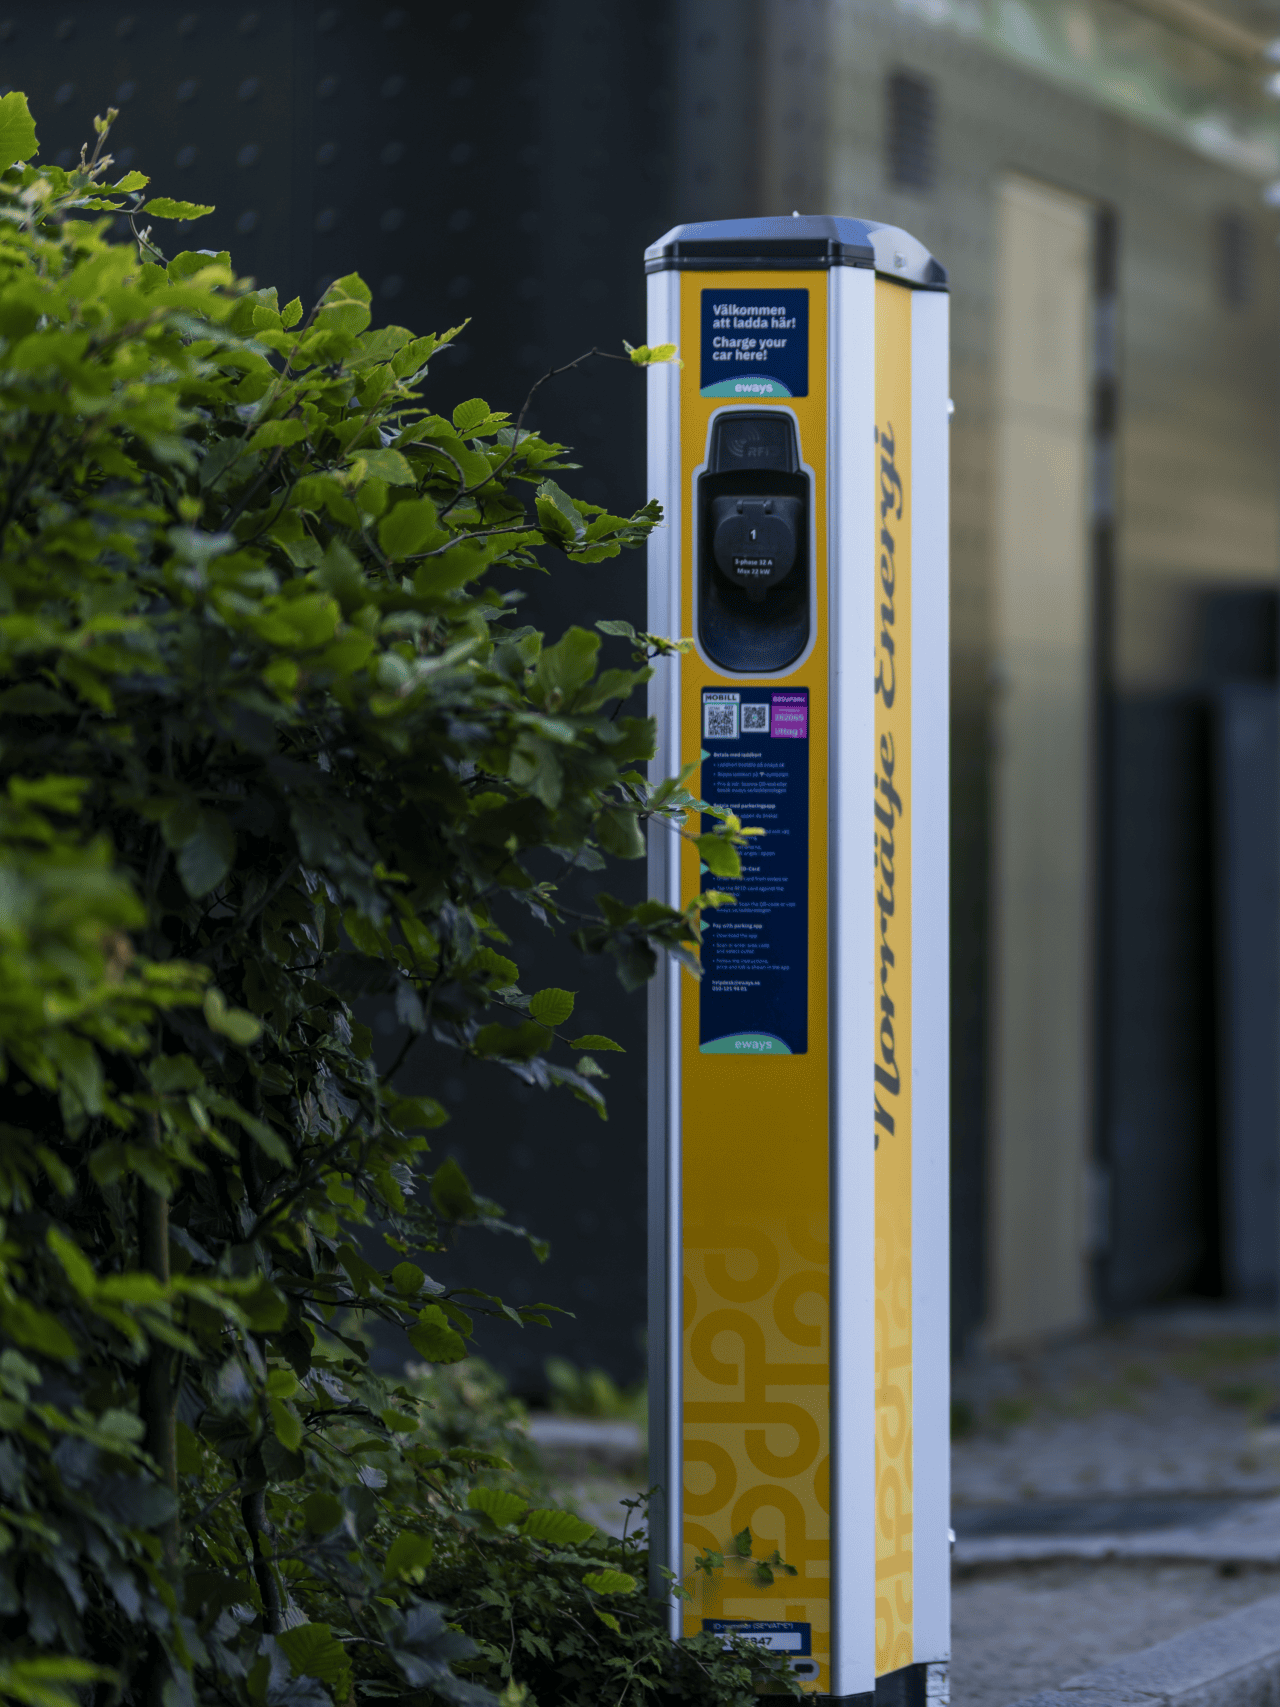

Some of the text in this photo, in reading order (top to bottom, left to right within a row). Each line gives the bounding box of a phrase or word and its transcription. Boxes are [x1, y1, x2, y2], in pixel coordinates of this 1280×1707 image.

[712, 303, 786, 316] Välkommen
[712, 316, 797, 329] att ladda här!
[712, 336, 787, 350] Charge your
[712, 349, 768, 361] car here!
[735, 384, 774, 395] eways
[750, 529, 757, 540] 1
[874, 420, 903, 1152] Norrtälje Energi
[735, 1041, 773, 1052] eways
